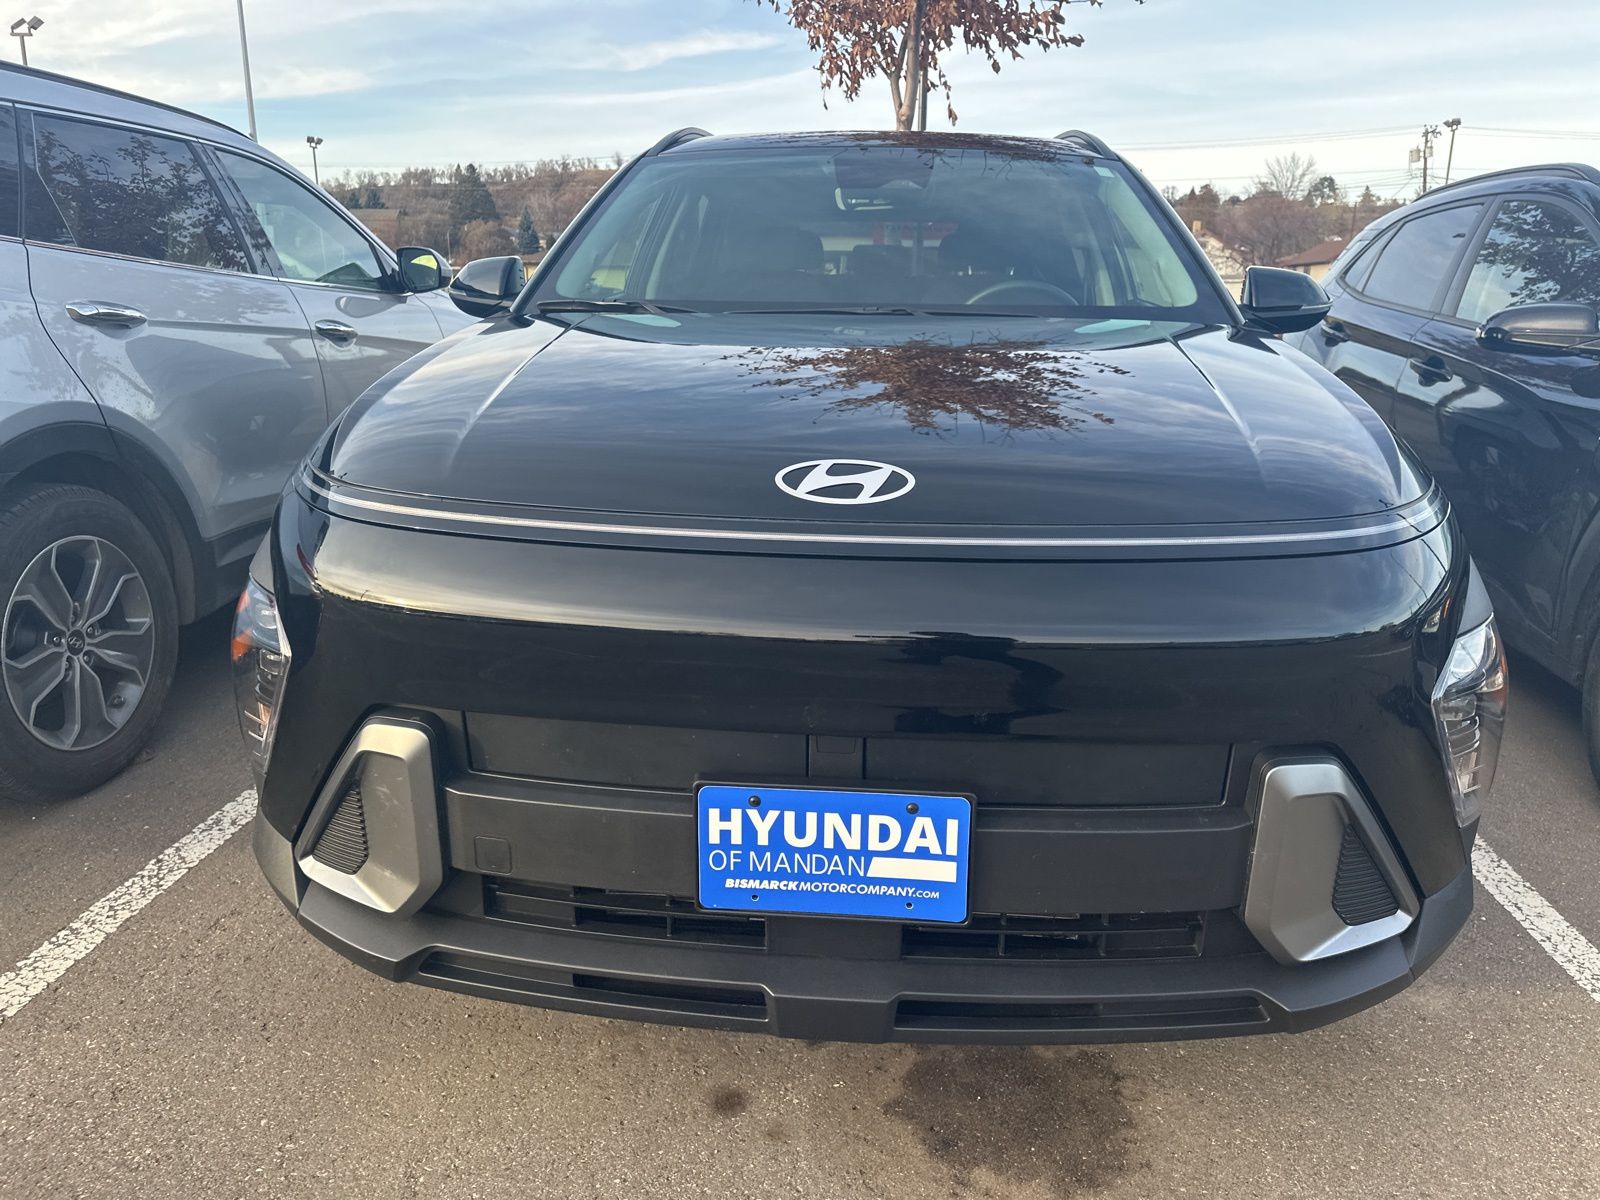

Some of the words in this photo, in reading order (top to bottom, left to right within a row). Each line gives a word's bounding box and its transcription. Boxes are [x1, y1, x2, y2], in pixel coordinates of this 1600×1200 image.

[708, 808, 958, 856] HYUNDAI
[708, 849, 742, 871] OF
[749, 851, 865, 877] MANDAN
